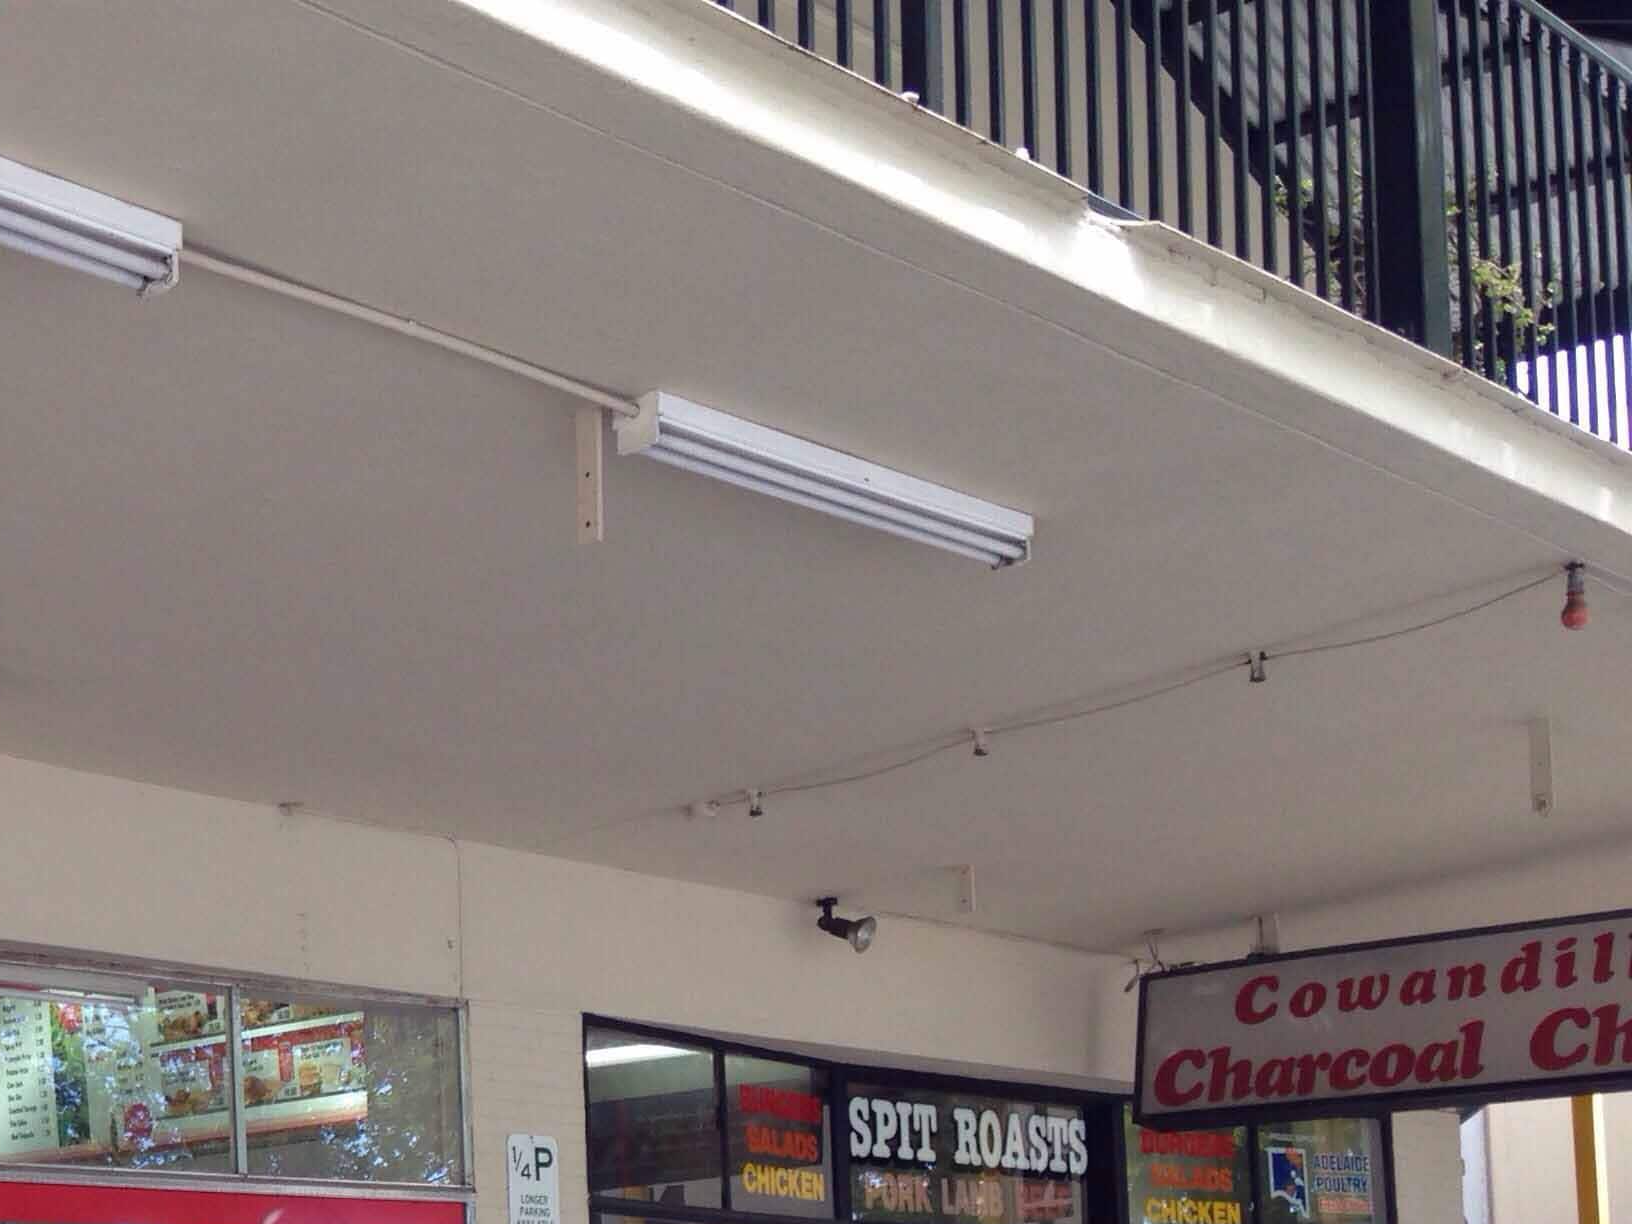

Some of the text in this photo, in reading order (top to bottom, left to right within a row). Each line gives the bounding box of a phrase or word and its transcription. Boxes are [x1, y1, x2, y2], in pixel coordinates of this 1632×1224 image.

[1235, 929, 1632, 1026] Cowandil
[1153, 1018, 1486, 1107] Charcoal
[848, 1097, 1087, 1176] SPIT ROASTS
[519, 1206, 551, 1217] PARKING
[742, 1162, 825, 1200] CHICKEN
